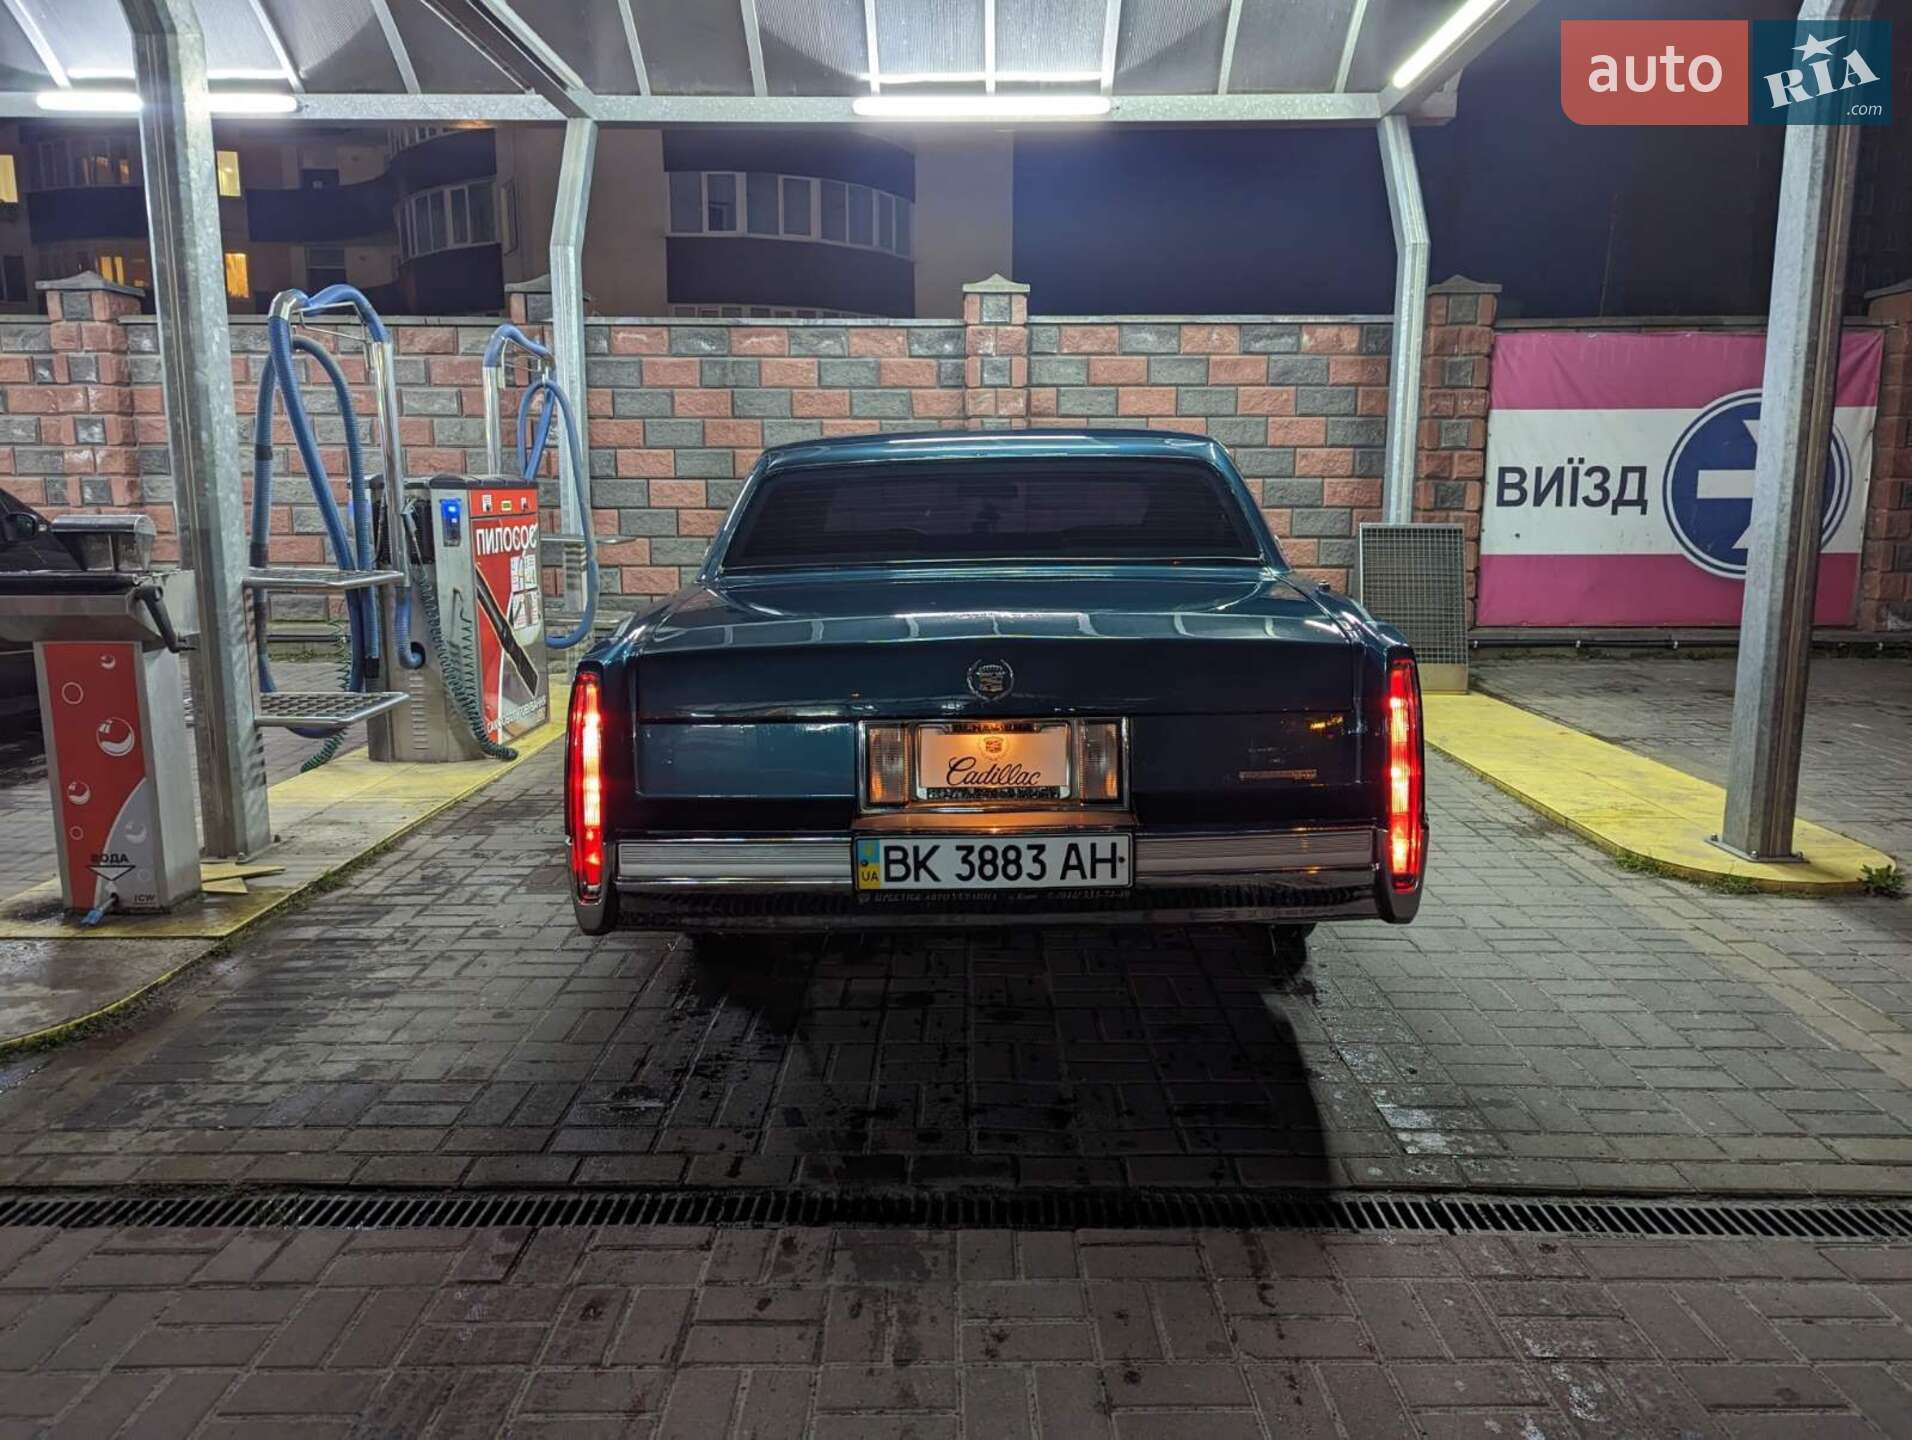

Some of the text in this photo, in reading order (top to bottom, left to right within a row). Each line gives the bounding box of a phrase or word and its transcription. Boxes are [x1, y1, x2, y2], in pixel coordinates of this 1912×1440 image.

[1496, 457, 1649, 516] ВИЇЗД
[946, 756, 1041, 786] Cadillac
[91, 854, 130, 864] ВОДА
[883, 842, 1118, 883] BK 3883 AH
[861, 871, 880, 882] UA
